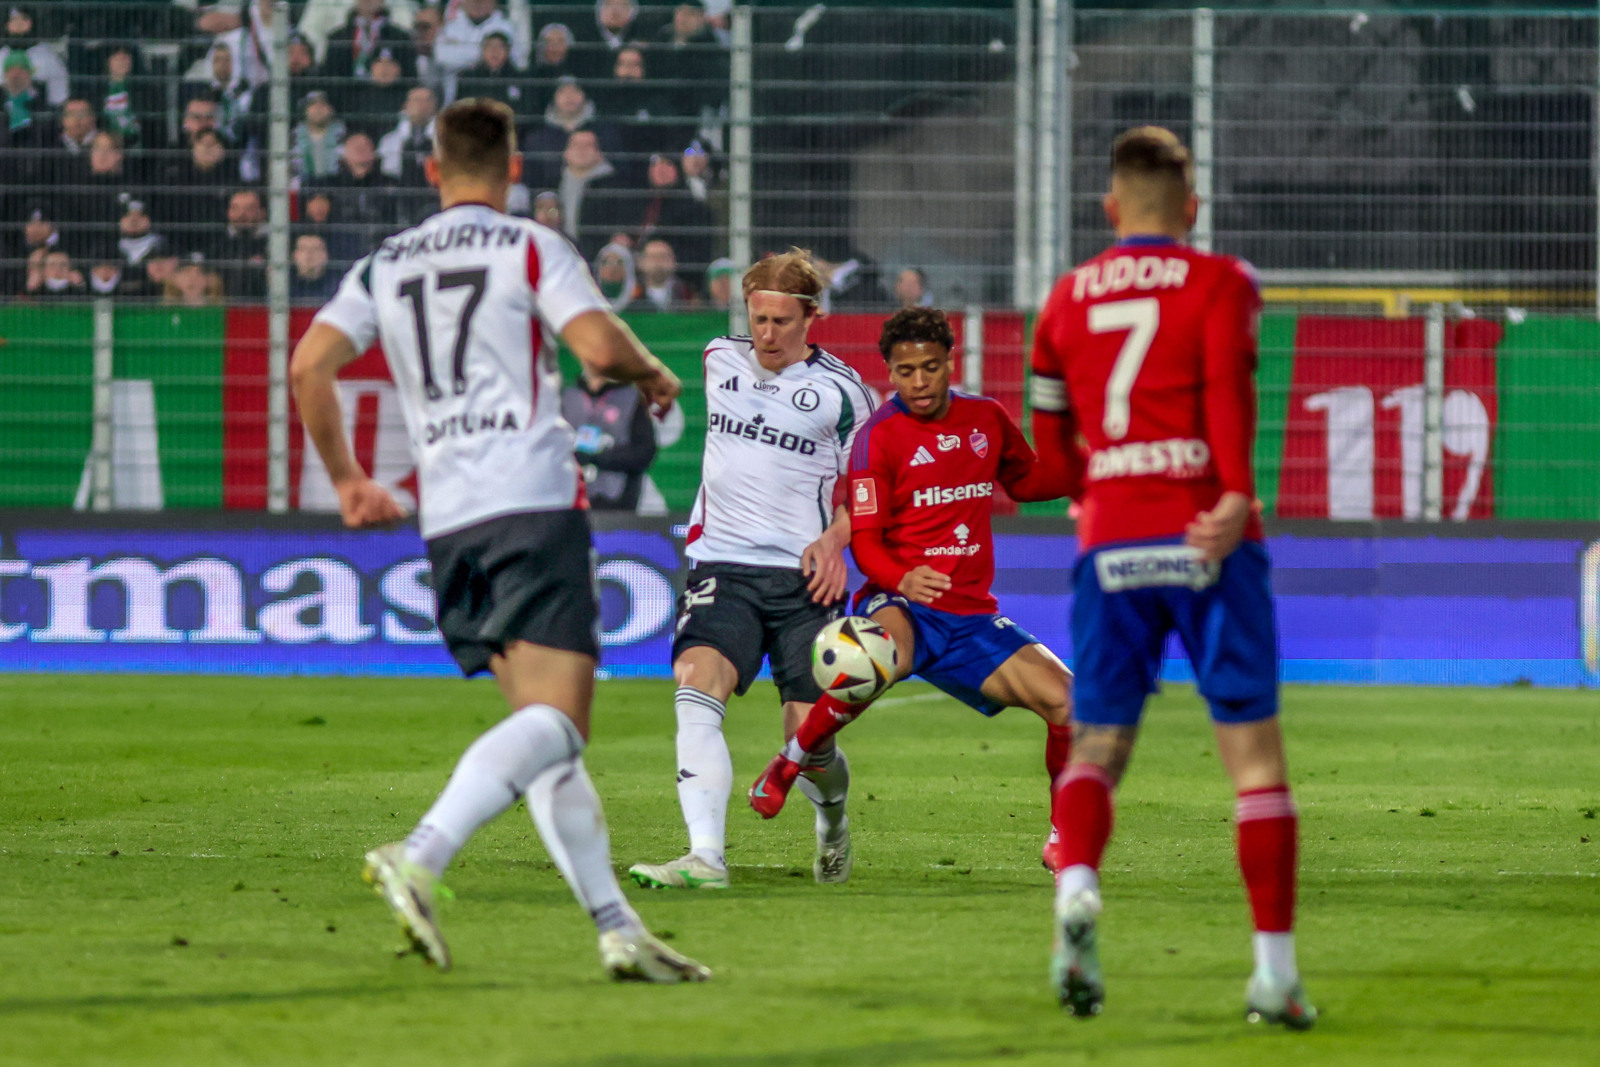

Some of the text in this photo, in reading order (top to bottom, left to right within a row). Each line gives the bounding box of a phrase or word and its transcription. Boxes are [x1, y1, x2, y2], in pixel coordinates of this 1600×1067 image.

[380, 222, 522, 262] SHKURYN
[1072, 255, 1190, 302] TUDOR
[397, 265, 488, 401] 17
[1087, 297, 1160, 440] 7
[913, 481, 993, 508] Hisense
[1304, 384, 1489, 522] 119
